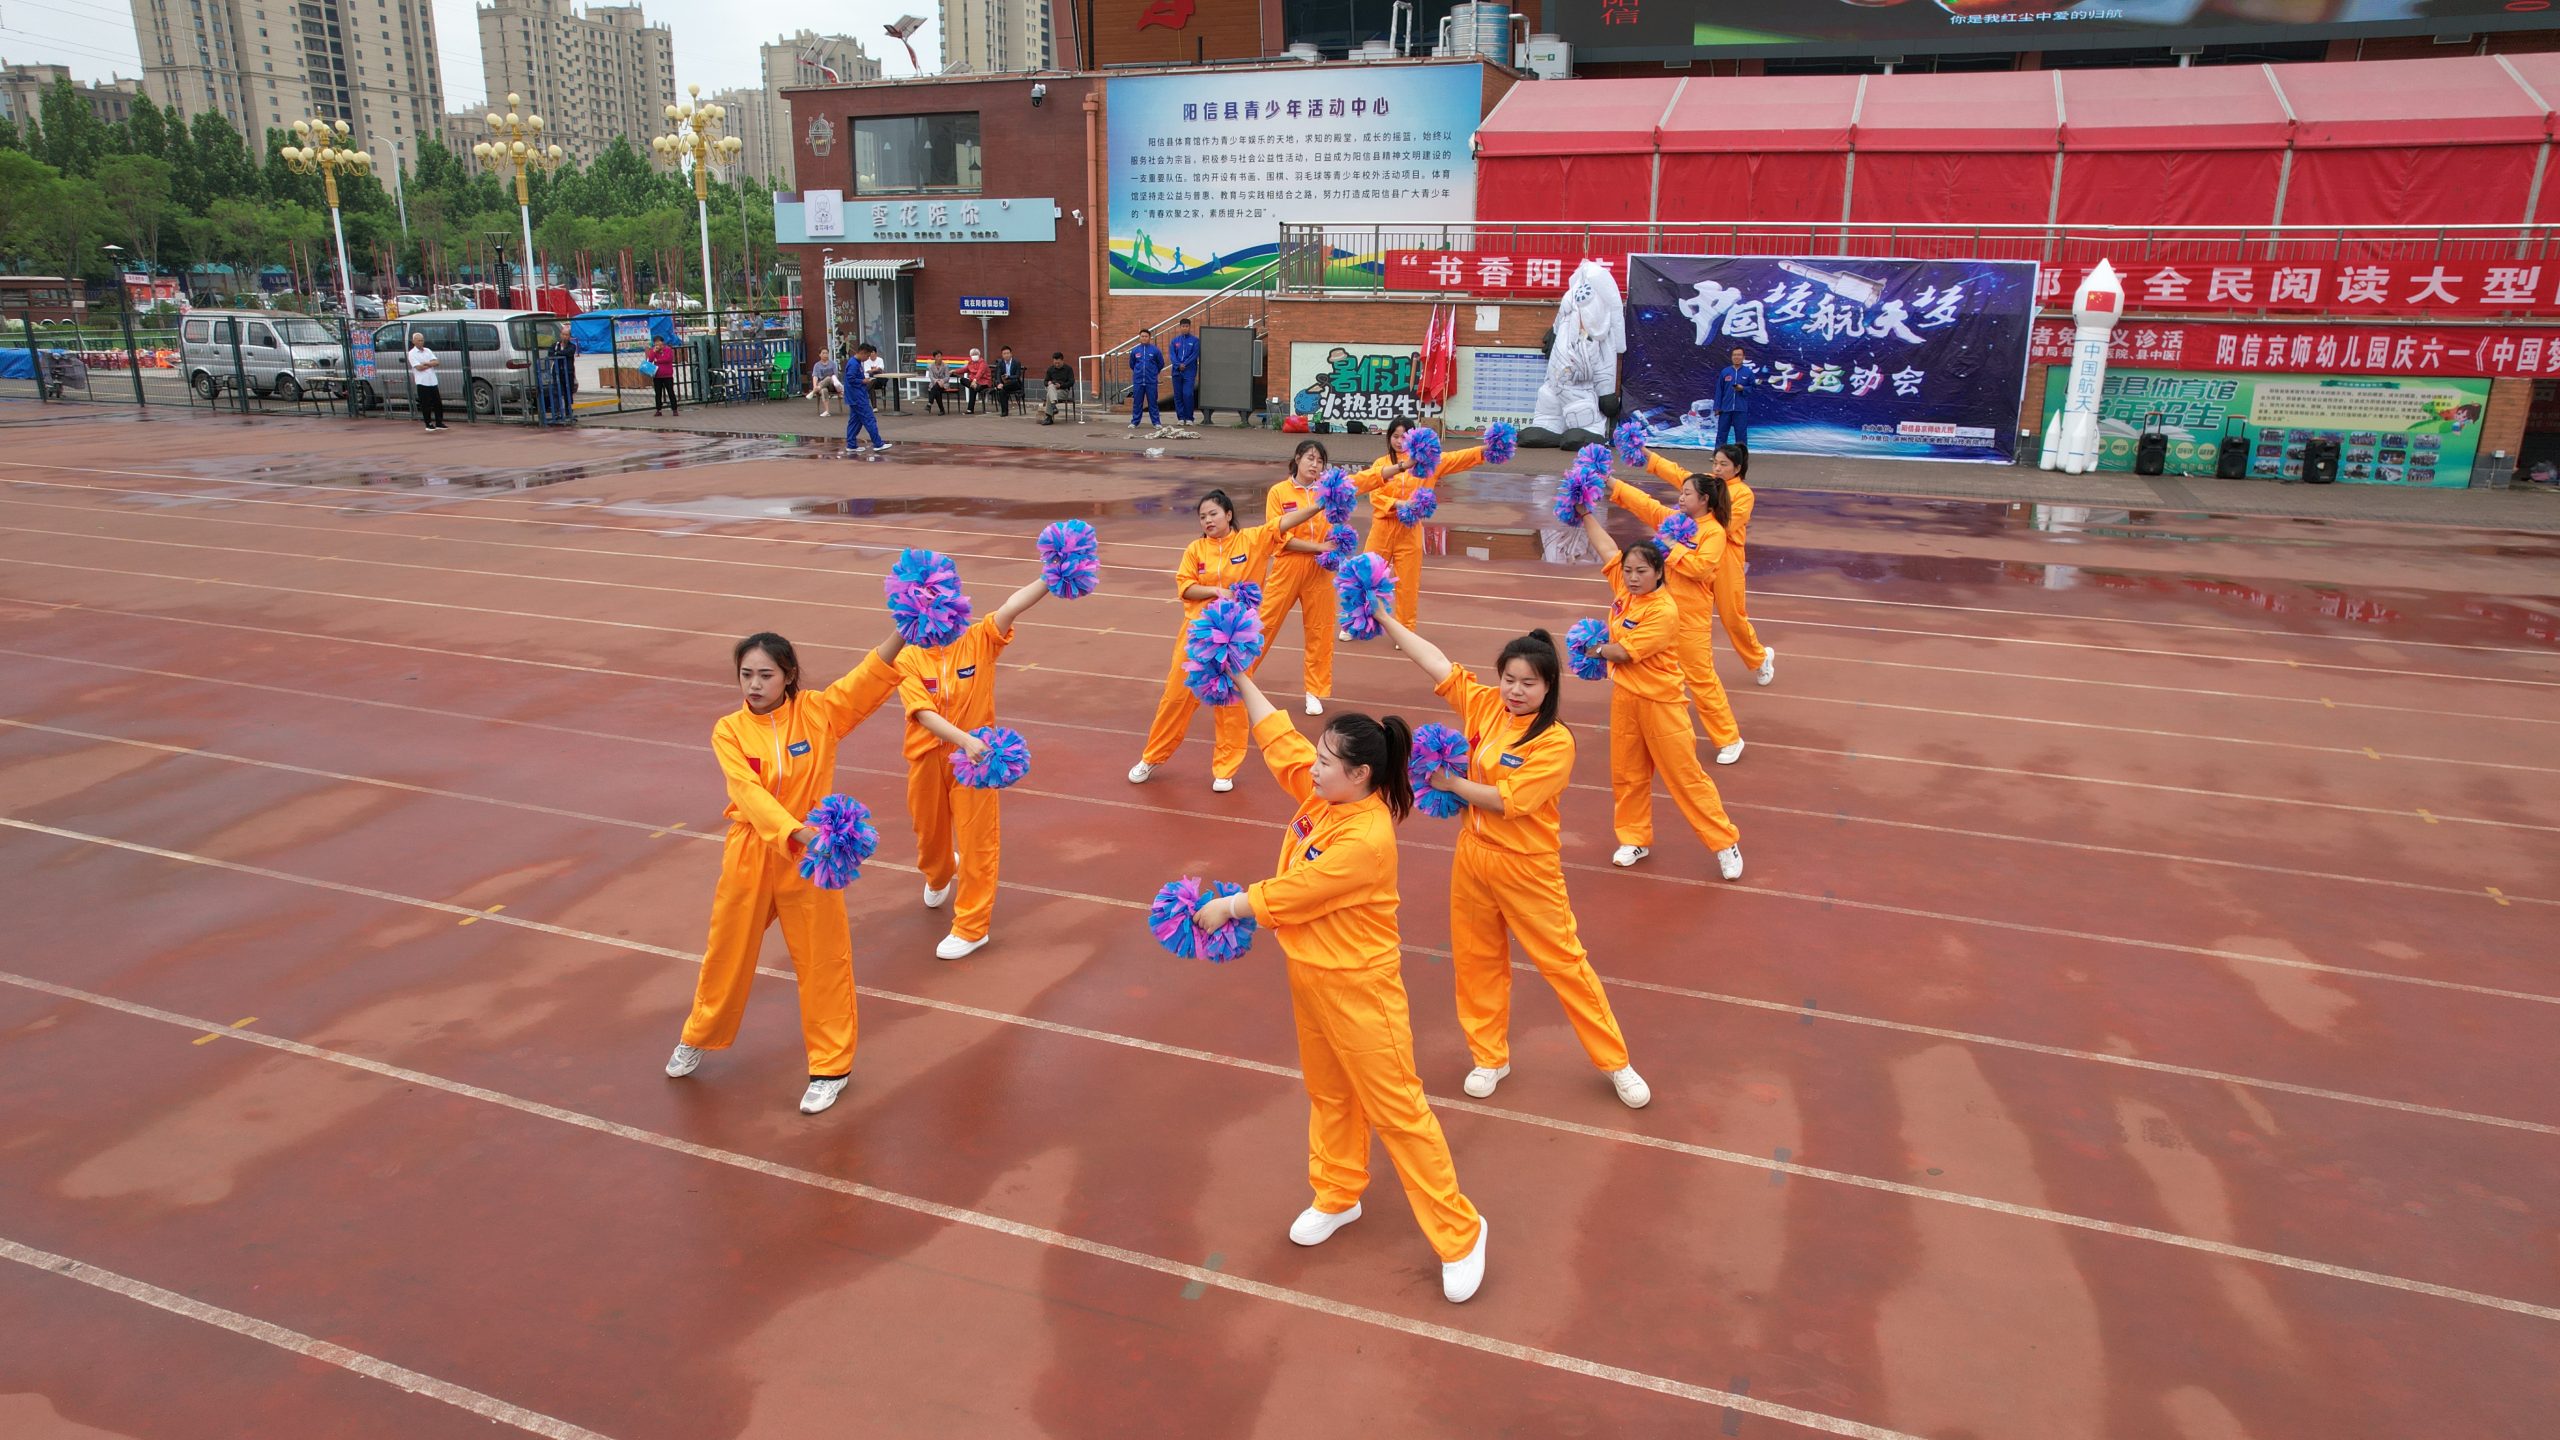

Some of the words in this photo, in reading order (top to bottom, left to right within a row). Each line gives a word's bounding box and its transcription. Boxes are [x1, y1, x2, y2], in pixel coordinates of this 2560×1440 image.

[1950, 9, 2123, 25] 你是我红尘中爱的归航
[1183, 96, 1390, 121] 阳信县青少年活动中心
[872, 200, 980, 229] 雪花陪你
[1679, 280, 1965, 346] 中国梦航天梦
[2032, 326, 2184, 349] 者免义诊活
[2076, 343, 2100, 412] 中国航天
